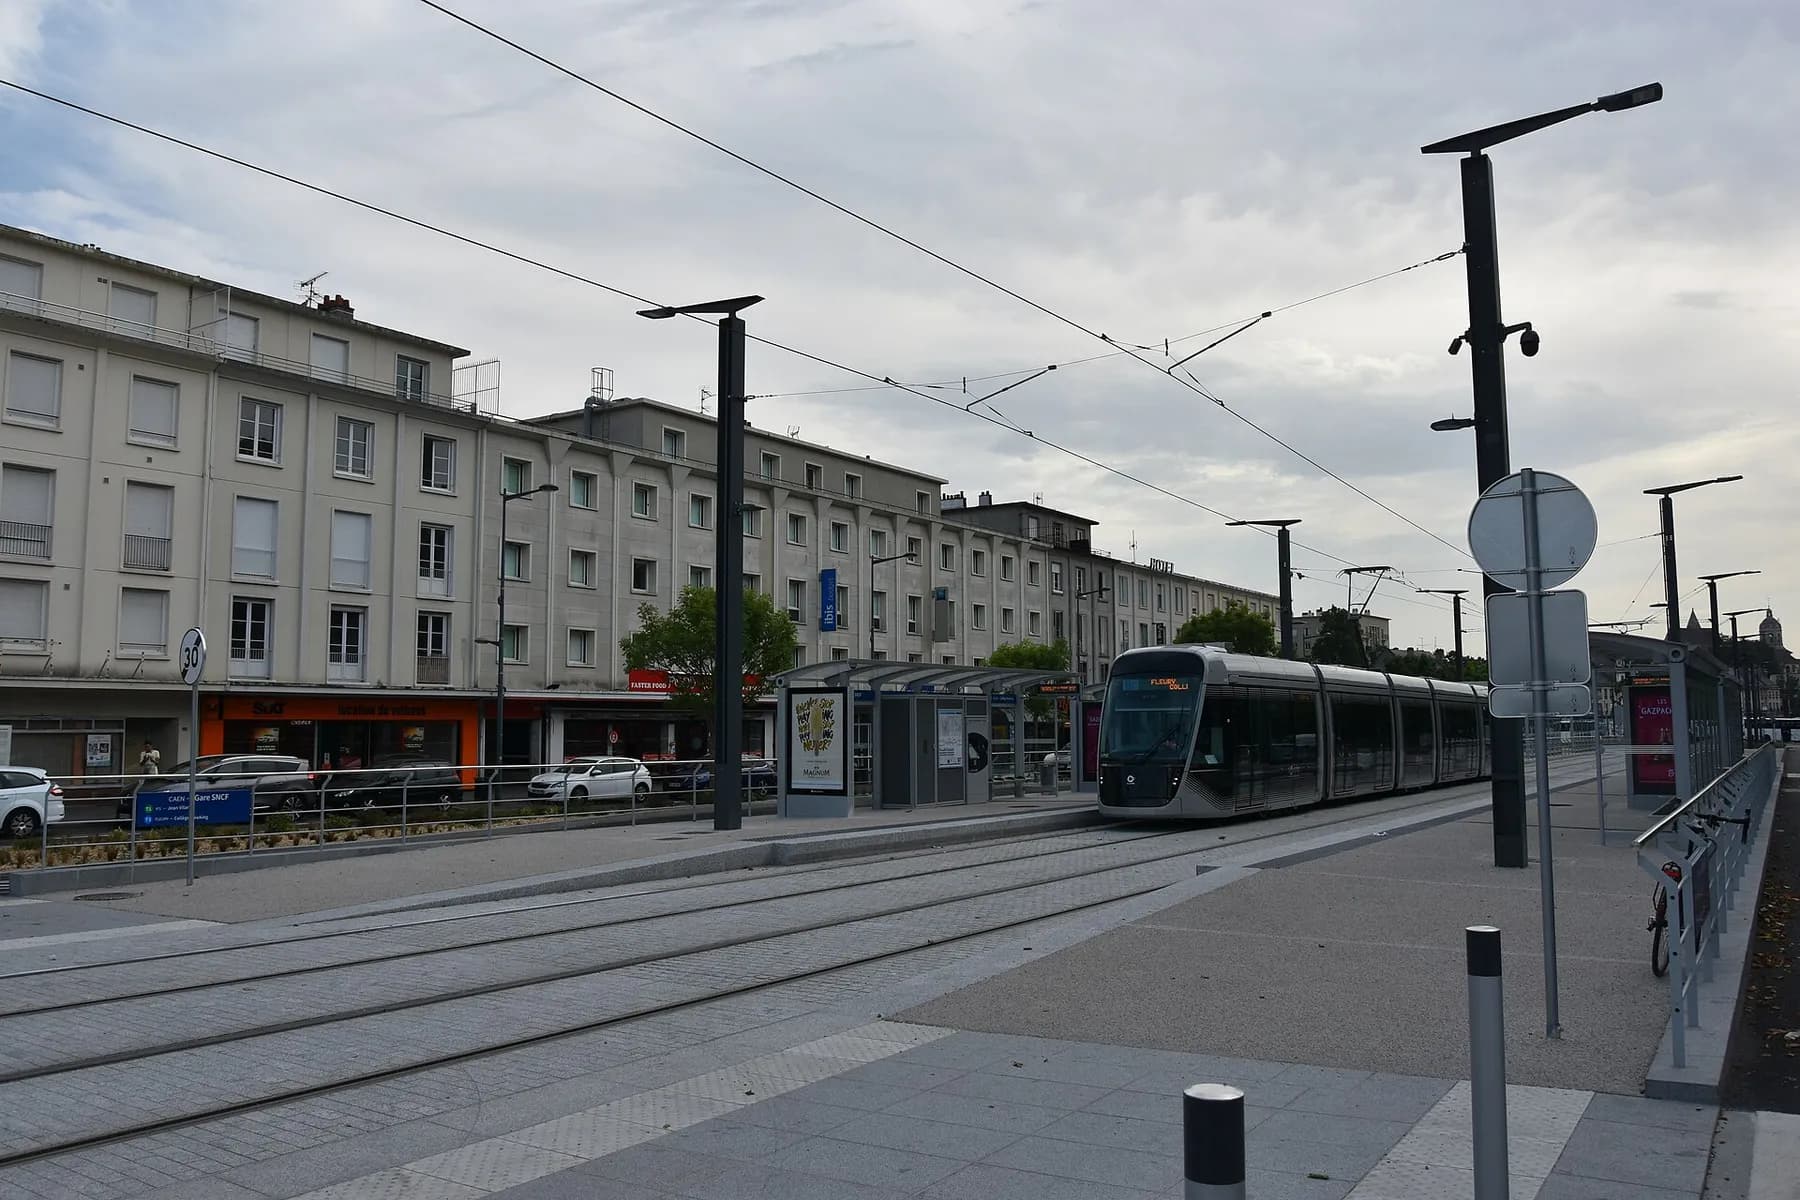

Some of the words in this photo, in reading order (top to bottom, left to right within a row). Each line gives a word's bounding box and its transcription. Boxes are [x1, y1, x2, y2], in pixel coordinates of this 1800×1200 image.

[824, 604, 834, 625] ibis
[184, 647, 199, 668] 30
[803, 769, 830, 777] MAGNUM
[168, 795, 185, 803] CAEN
[194, 794, 211, 802] Gare
[211, 793, 229, 801] SNCF
